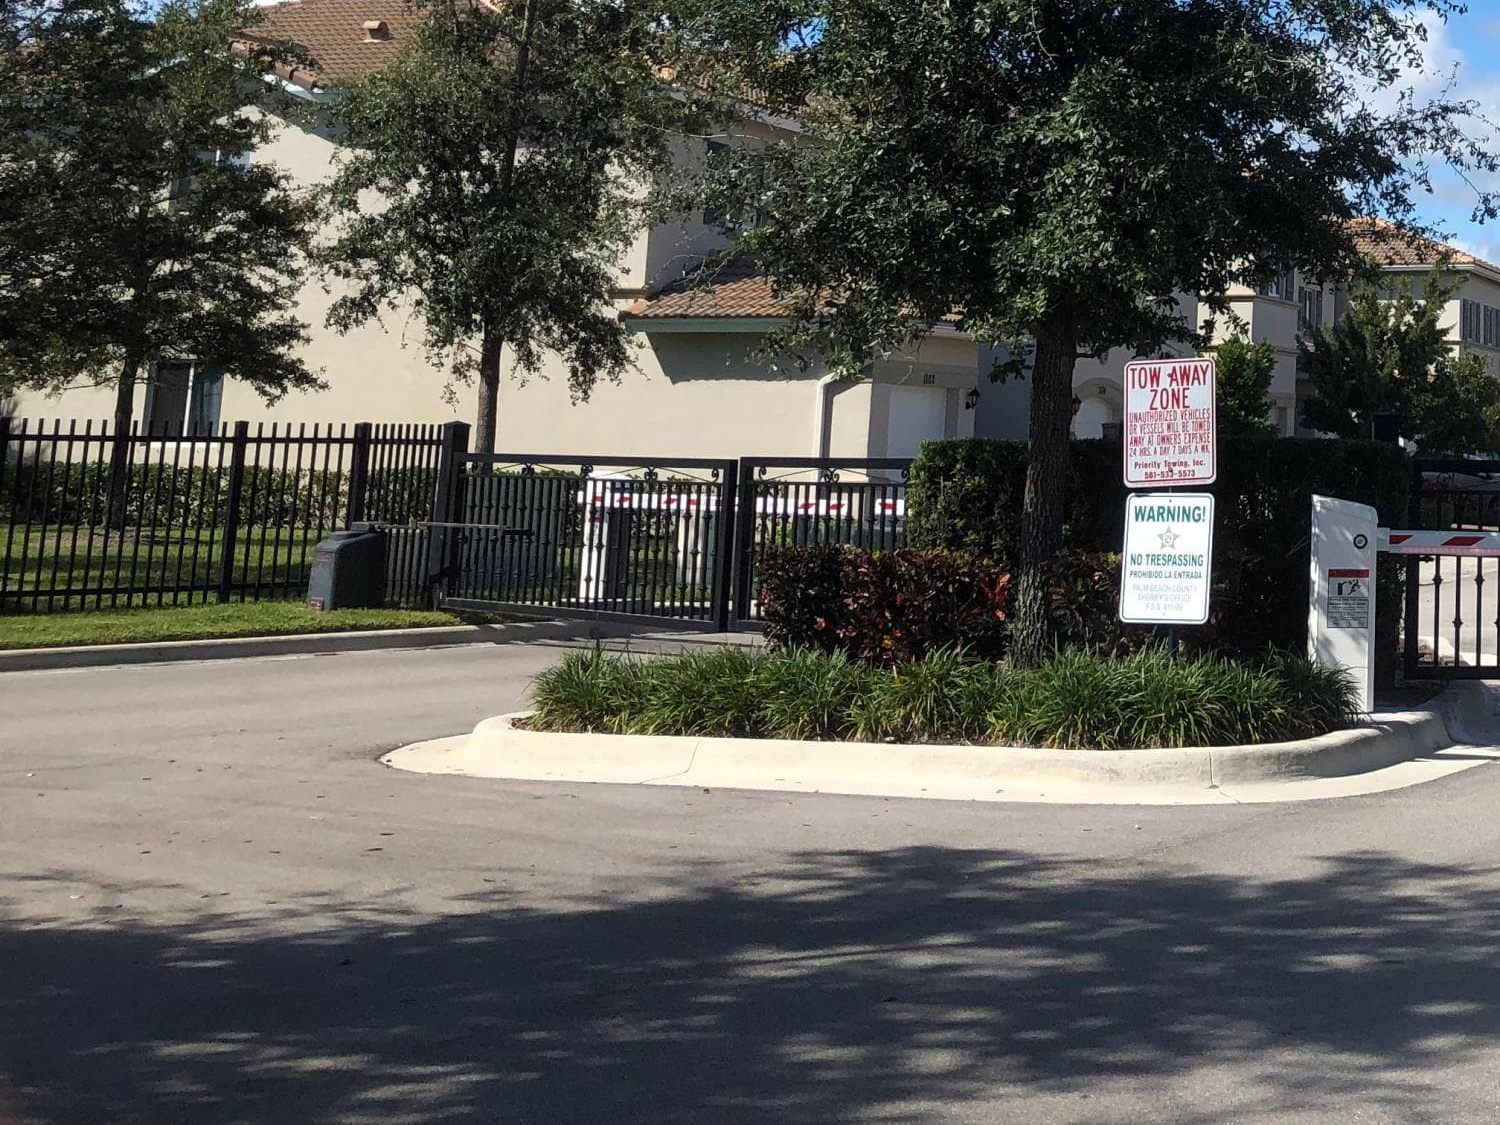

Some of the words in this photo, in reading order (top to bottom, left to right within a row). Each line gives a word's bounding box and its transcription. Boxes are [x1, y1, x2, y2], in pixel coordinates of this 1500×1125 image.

[1129, 366, 1161, 389] TOW
[1169, 364, 1209, 387] AWAY
[1149, 387, 1190, 410] ZONE
[1129, 410, 1178, 423] UNAUTHORIZED
[1180, 408, 1211, 421] VEHICLES
[1129, 423, 1138, 436] OR
[1139, 422, 1165, 435] VESSELS
[1167, 421, 1180, 433] WILL
[1182, 421, 1189, 433] BE
[1192, 420, 1211, 432] TOWED
[1129, 435, 1145, 447] AWAY
[1147, 434, 1154, 446] AT
[1156, 433, 1182, 446] OWNERS
[1184, 432, 1211, 445] EXPENSE
[1129, 448, 1137, 457] 24
[1153, 447, 1158, 456] A
[1159, 446, 1171, 456] DAY
[1178, 445, 1192, 455] DAYS
[1194, 445, 1199, 454] A
[1134, 461, 1161, 469] Priority
[1193, 458, 1206, 467] Inc.
[1134, 505, 1206, 523] WARNING!
[1130, 553, 1143, 566] NO
[1145, 554, 1204, 567] TRESPASSING
[1129, 570, 1163, 579] PROHIBIDO
[1164, 571, 1172, 579] LA
[1173, 571, 1202, 579] ENTRADA
